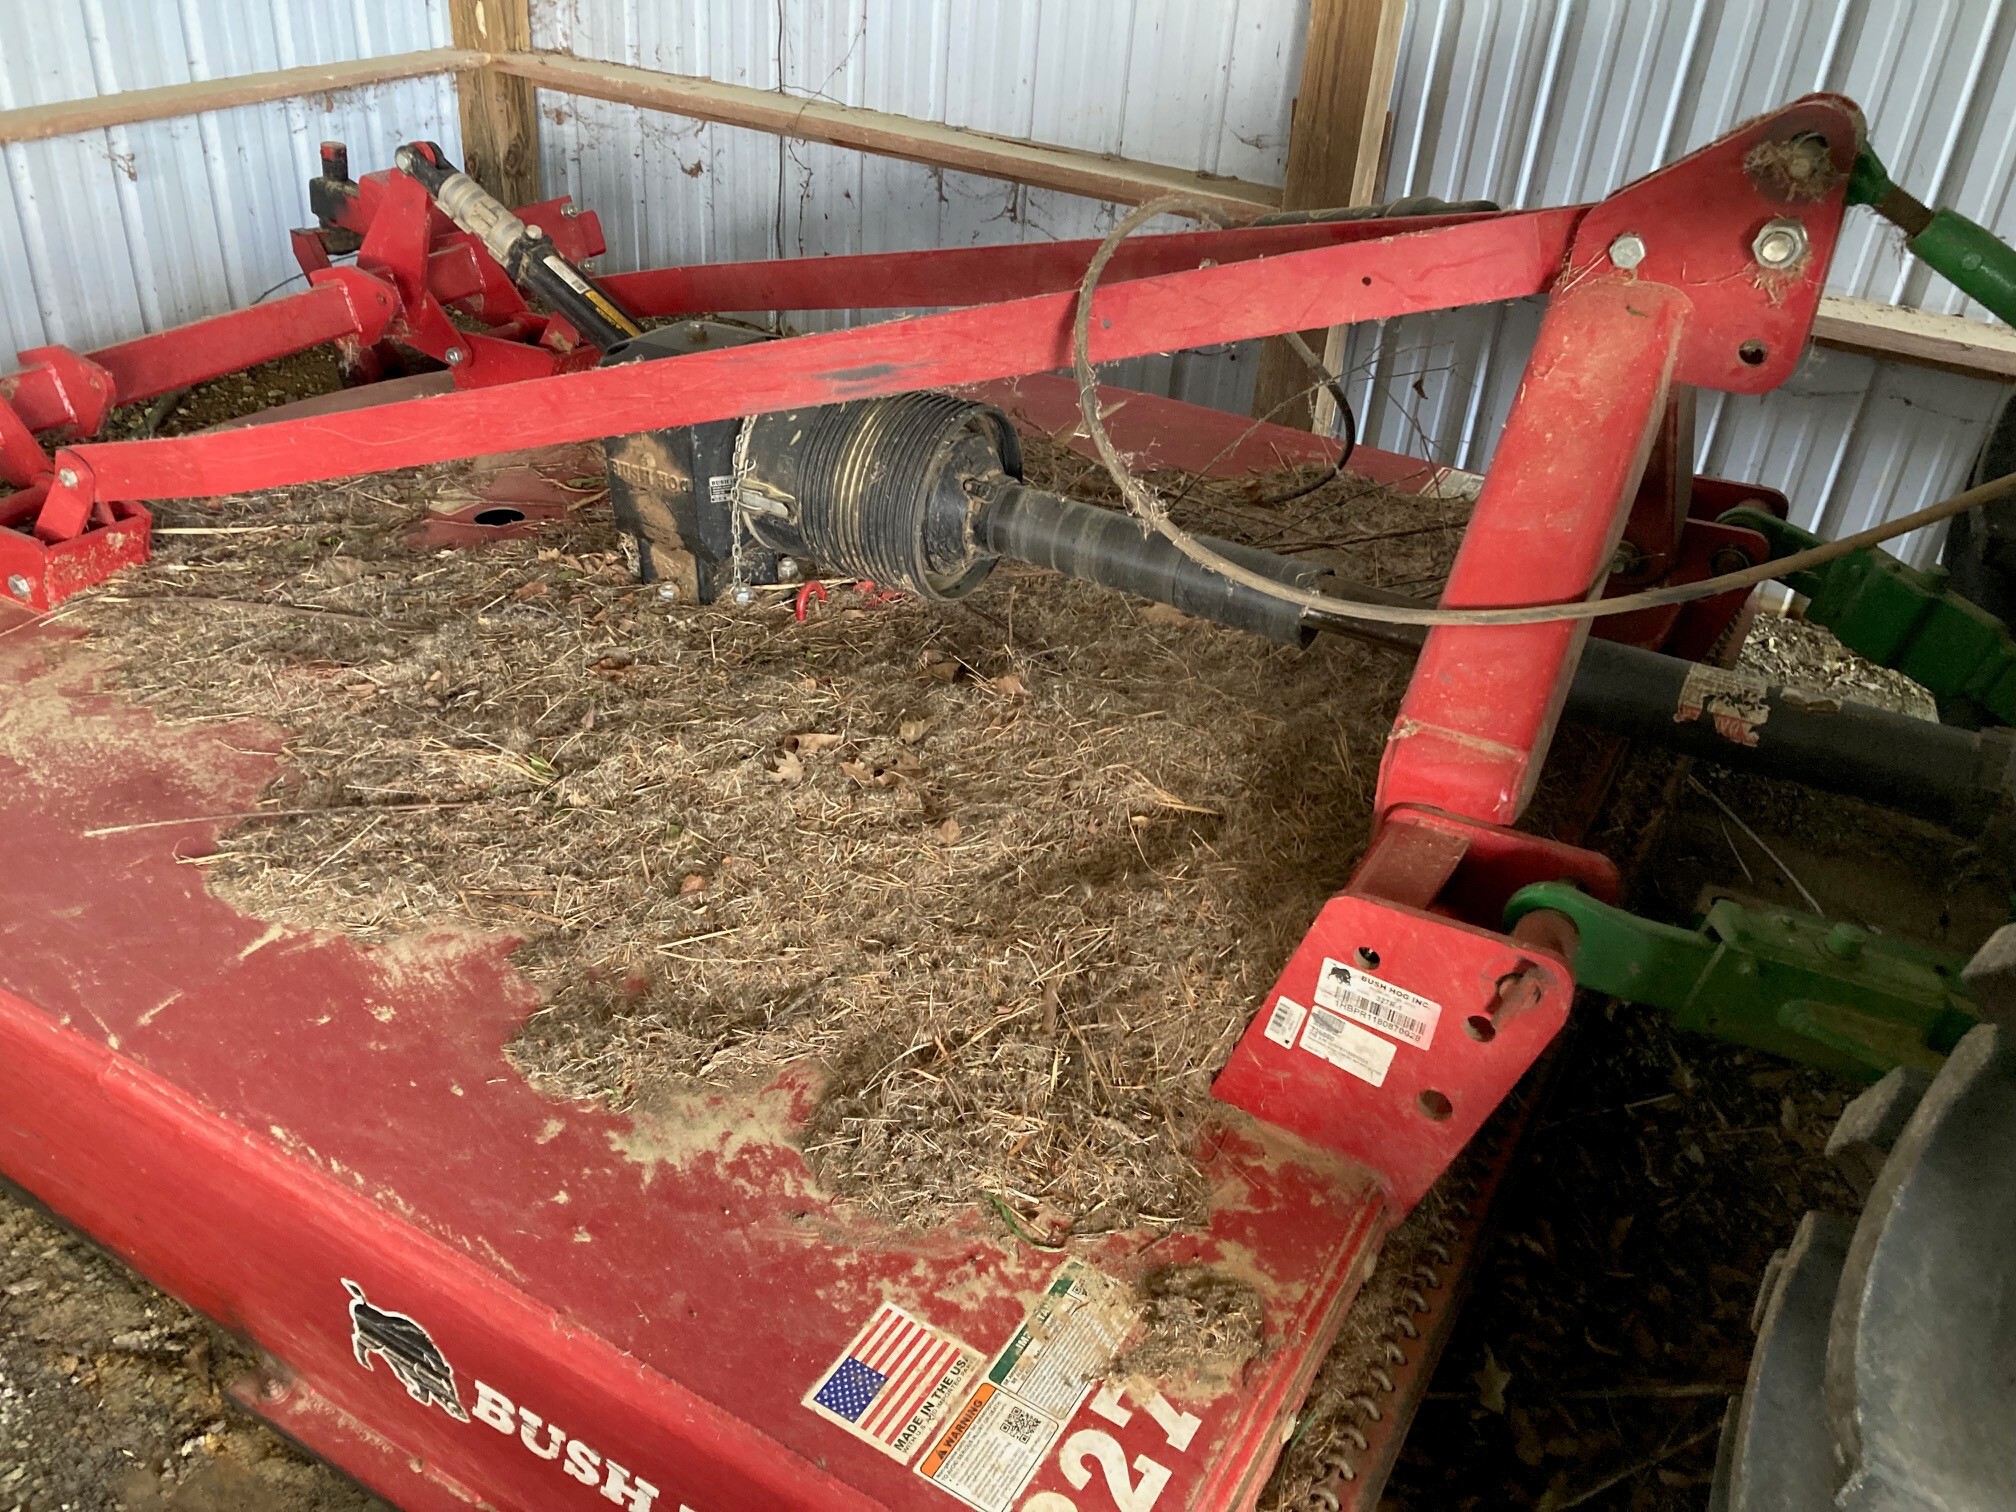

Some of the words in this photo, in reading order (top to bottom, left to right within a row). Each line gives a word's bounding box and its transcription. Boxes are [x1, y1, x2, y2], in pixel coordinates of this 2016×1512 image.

[610, 458, 654, 486] BUSH
[1360, 975, 1387, 990] BUSH
[1388, 987, 1410, 1000] HOG
[472, 1379, 660, 1512] BUSH
[893, 1414, 923, 1451] MADE
[919, 1400, 935, 1417] IN
[931, 1374, 953, 1402] THE
[901, 1435, 917, 1454] WITH
[935, 1375, 962, 1409] IMPORTED
[942, 1396, 983, 1449] WARNING
[1022, 1380, 1203, 1512] 27
[941, 1473, 948, 1481] TO
[946, 1459, 959, 1475] AVOID
[956, 1439, 973, 1460] SERIOUS
[971, 1422, 985, 1440] INJURY
